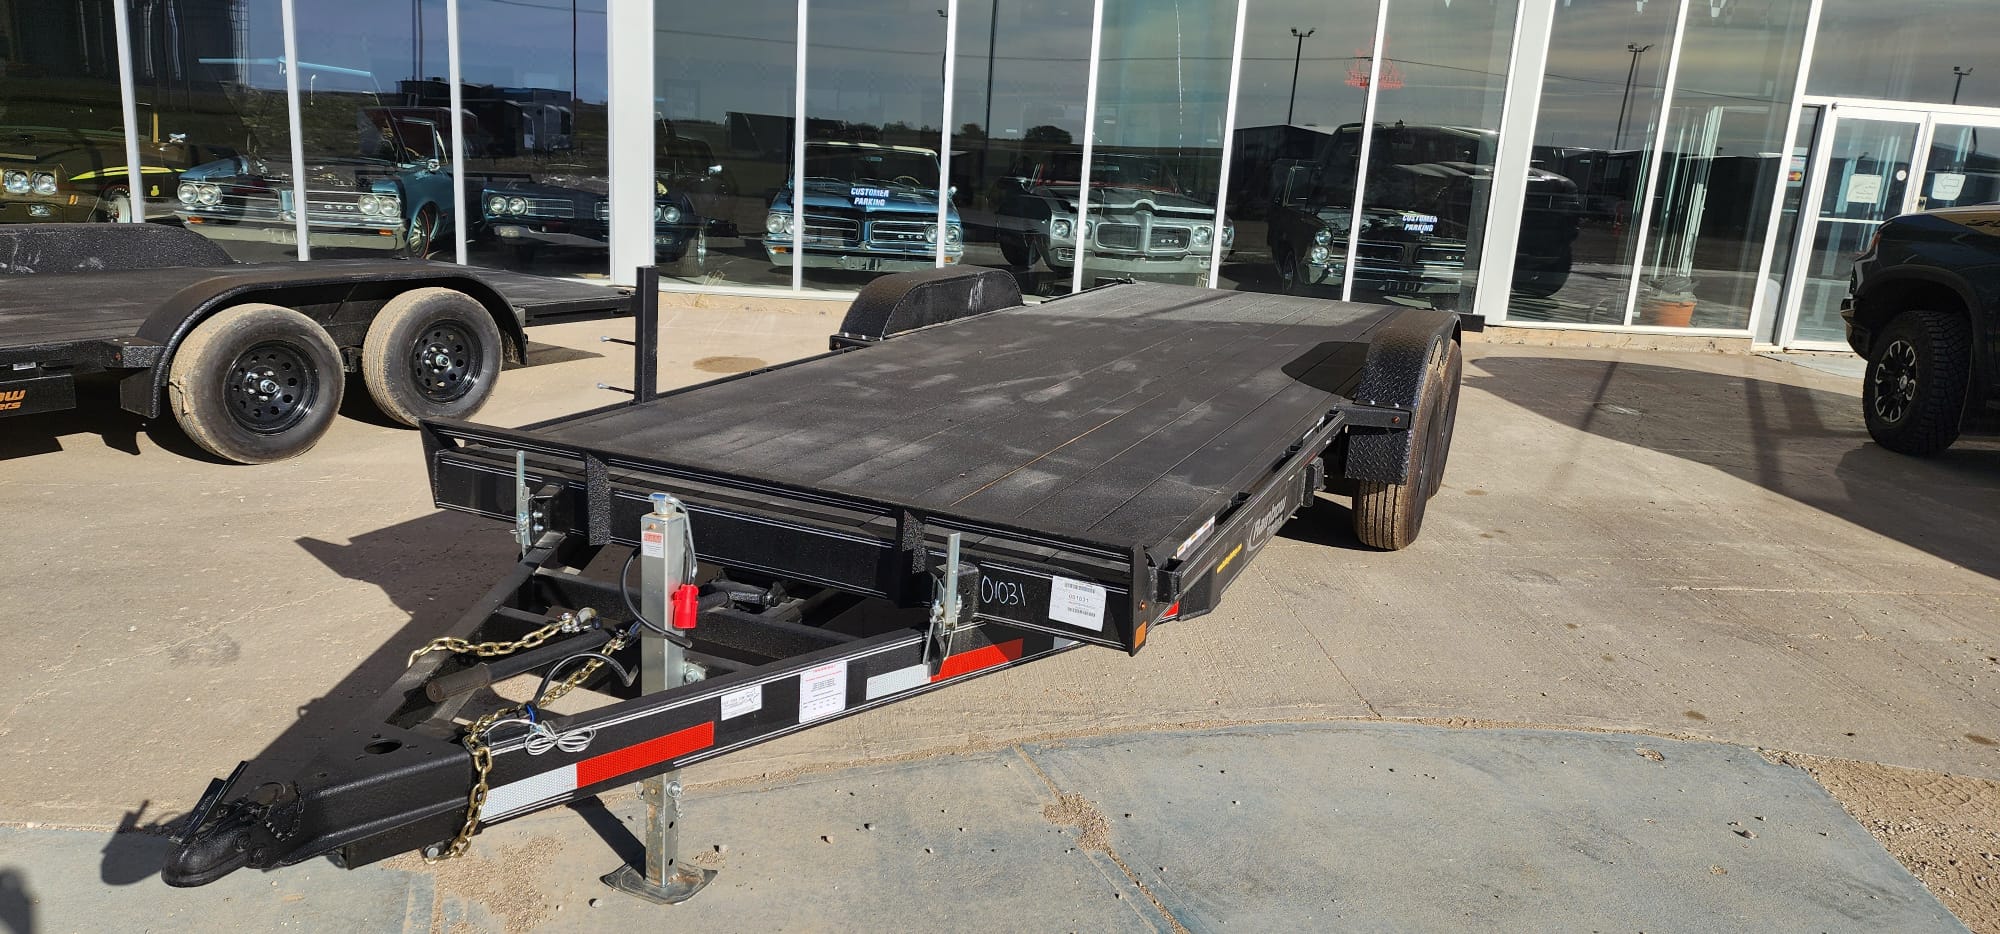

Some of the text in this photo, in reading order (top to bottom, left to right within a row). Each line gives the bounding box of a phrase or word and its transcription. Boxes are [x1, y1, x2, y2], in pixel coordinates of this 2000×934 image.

[850, 187, 890, 198] CUSTOMER
[853, 197, 886, 207] PARKING
[1404, 223, 1434, 232] PARKING
[981, 575, 1026, 607] 01031
